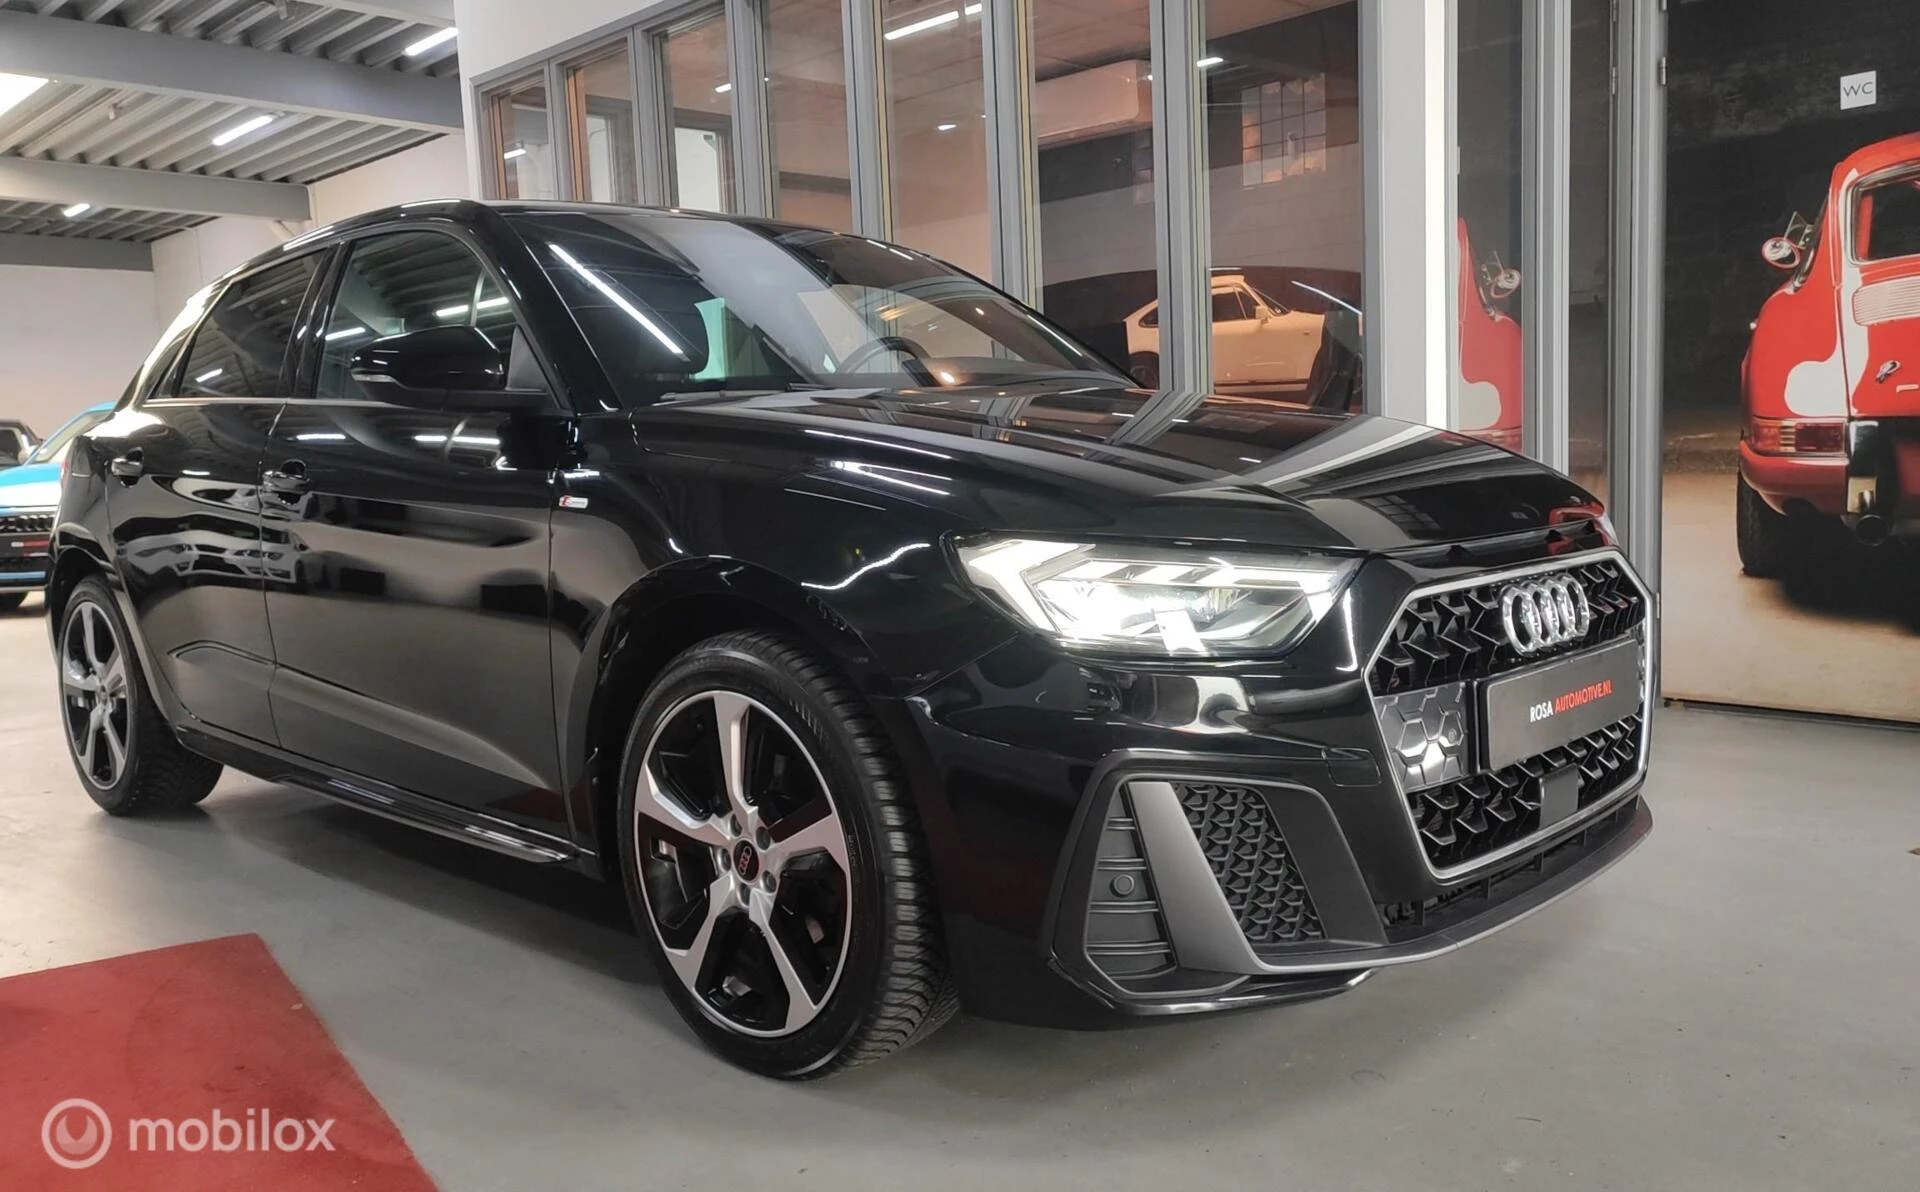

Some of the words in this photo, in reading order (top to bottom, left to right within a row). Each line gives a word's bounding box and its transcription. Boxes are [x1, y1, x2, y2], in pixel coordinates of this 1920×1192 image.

[1843, 81, 1873, 97] WC
[1530, 701, 1554, 722] ROSA
[1555, 680, 1612, 714] AUTOMOTIVE.NL
